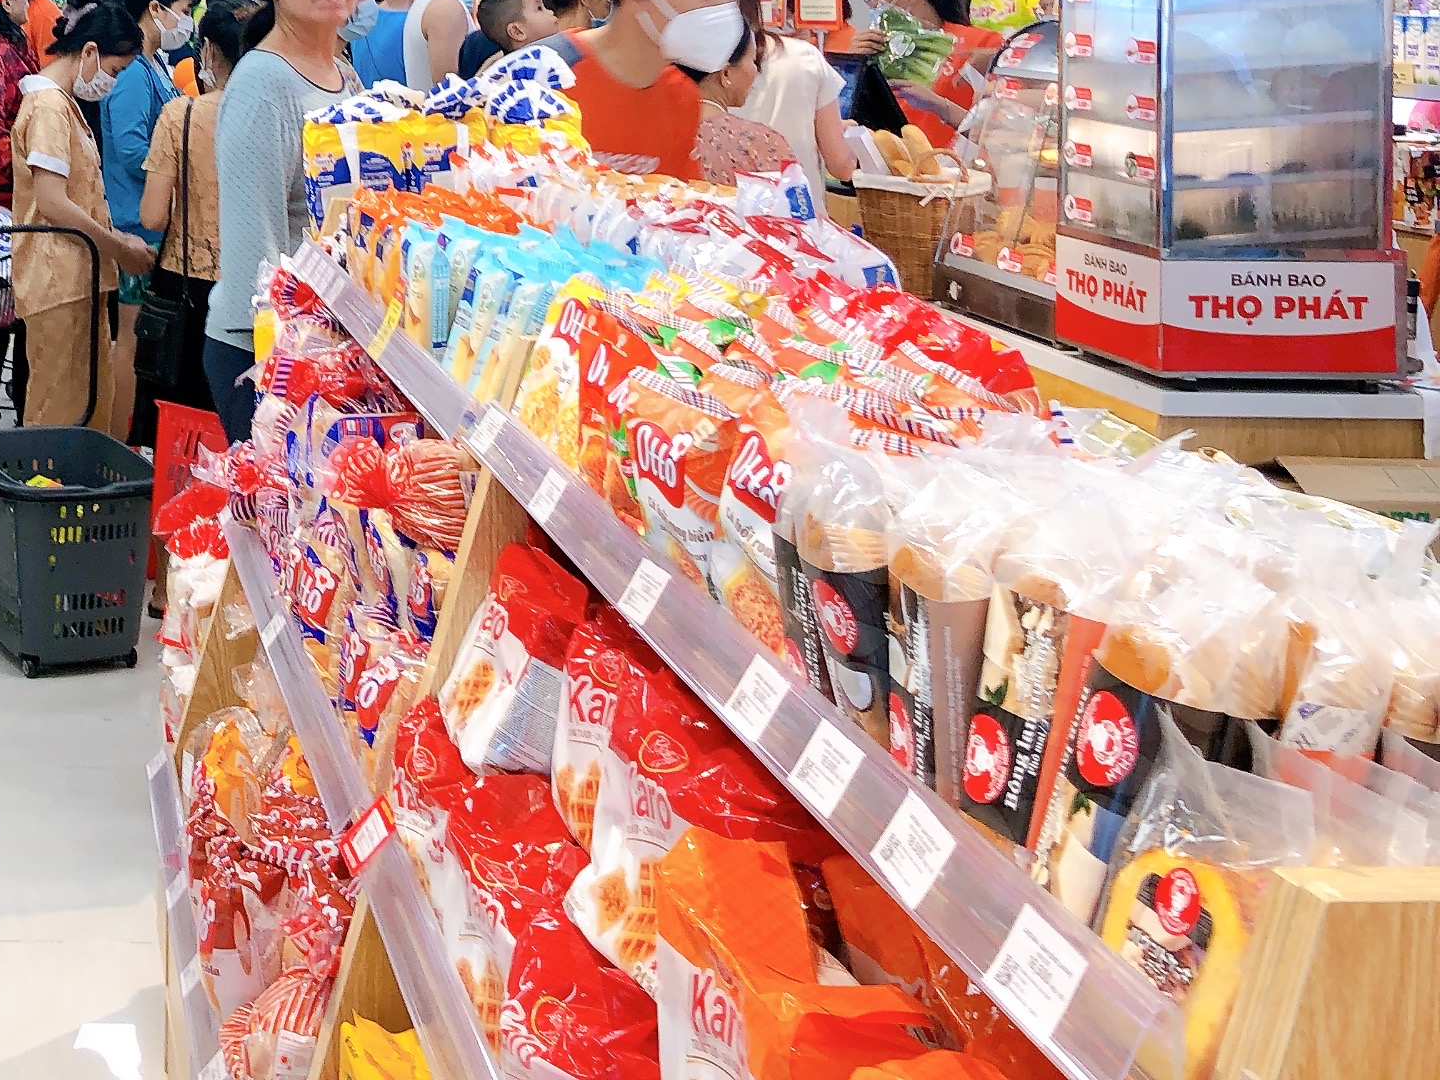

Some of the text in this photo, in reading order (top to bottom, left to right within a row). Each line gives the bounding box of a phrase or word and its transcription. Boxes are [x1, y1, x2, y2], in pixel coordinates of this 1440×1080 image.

[1084, 253, 1128, 276] BÁNH BAO
[1231, 270, 1327, 287] BÁNH BAO
[1066, 268, 1147, 313] THỌ PHÁT
[1189, 287, 1368, 327] THỌ PHÁT
[691, 970, 740, 1050] Kar
